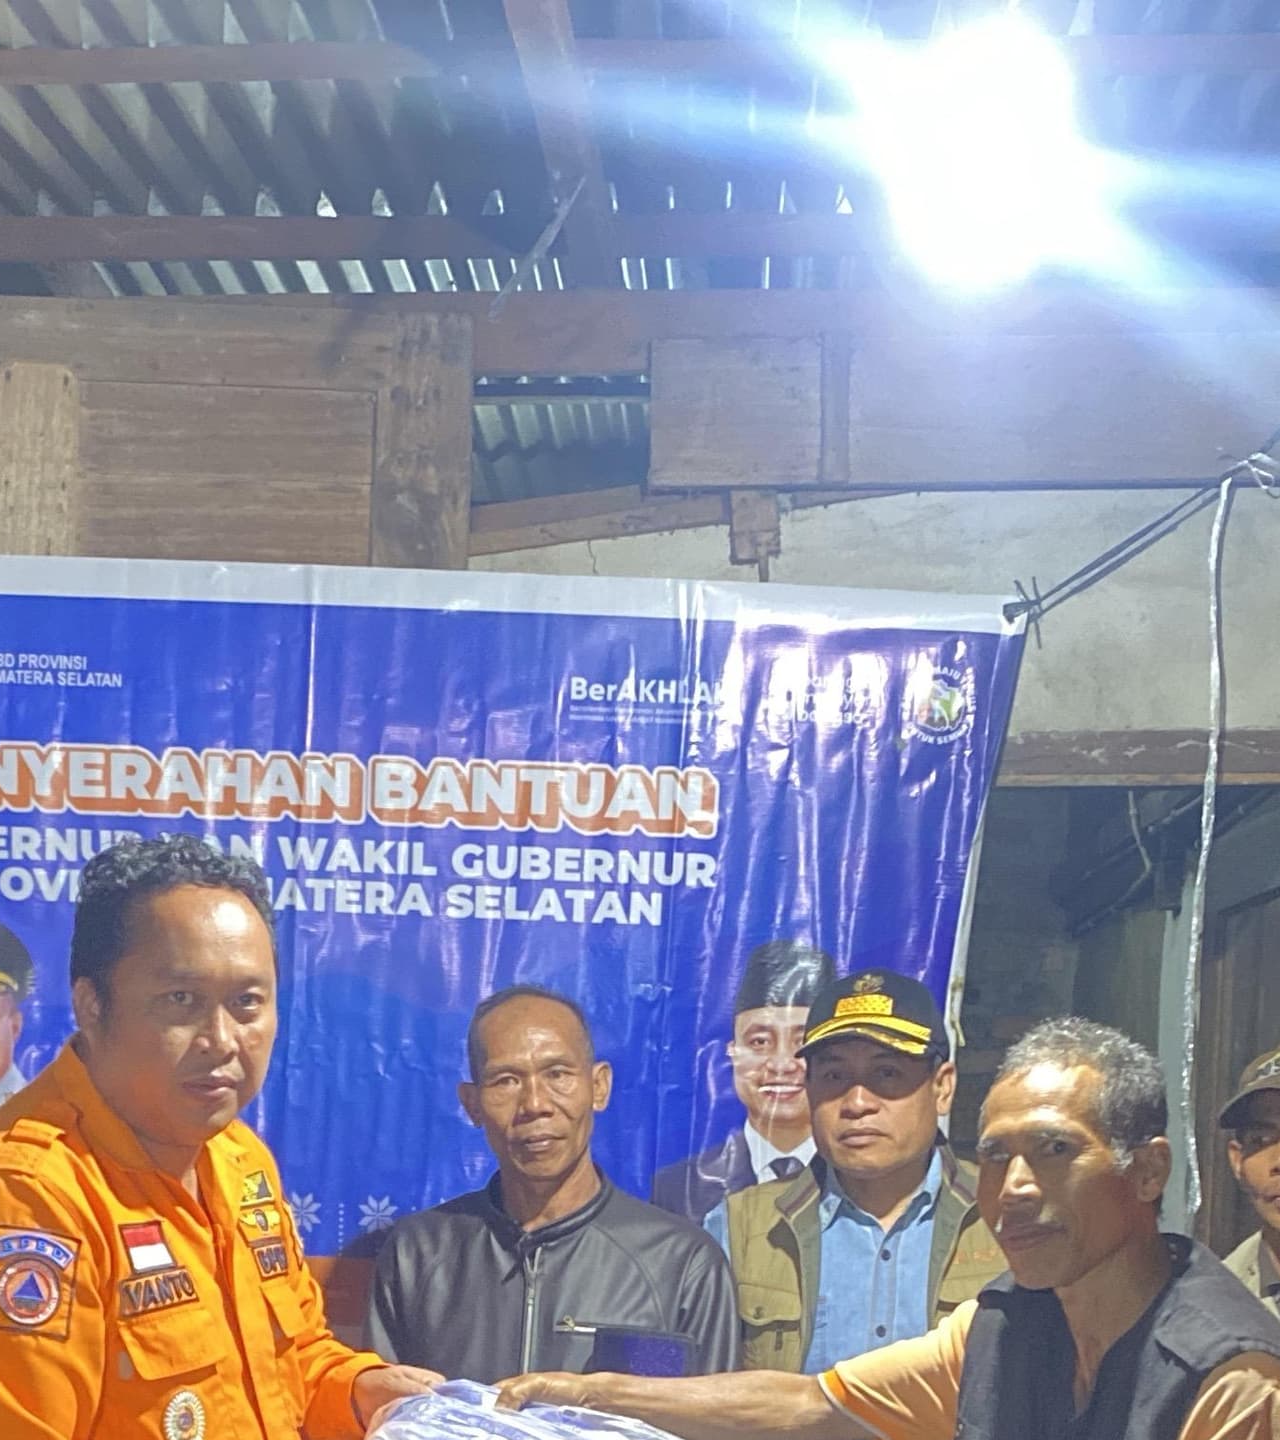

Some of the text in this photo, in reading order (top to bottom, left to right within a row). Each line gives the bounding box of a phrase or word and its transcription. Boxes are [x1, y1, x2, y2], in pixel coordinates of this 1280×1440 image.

[19, 654, 87, 670] PROVINSI
[57, 671, 123, 687] SELATAN
[370, 756, 715, 833] BANTUAN
[278, 836, 438, 877] WAKIL
[451, 843, 717, 888] GUBERNUR
[266, 877, 434, 917] ATERA
[445, 883, 663, 926] SELATAN
